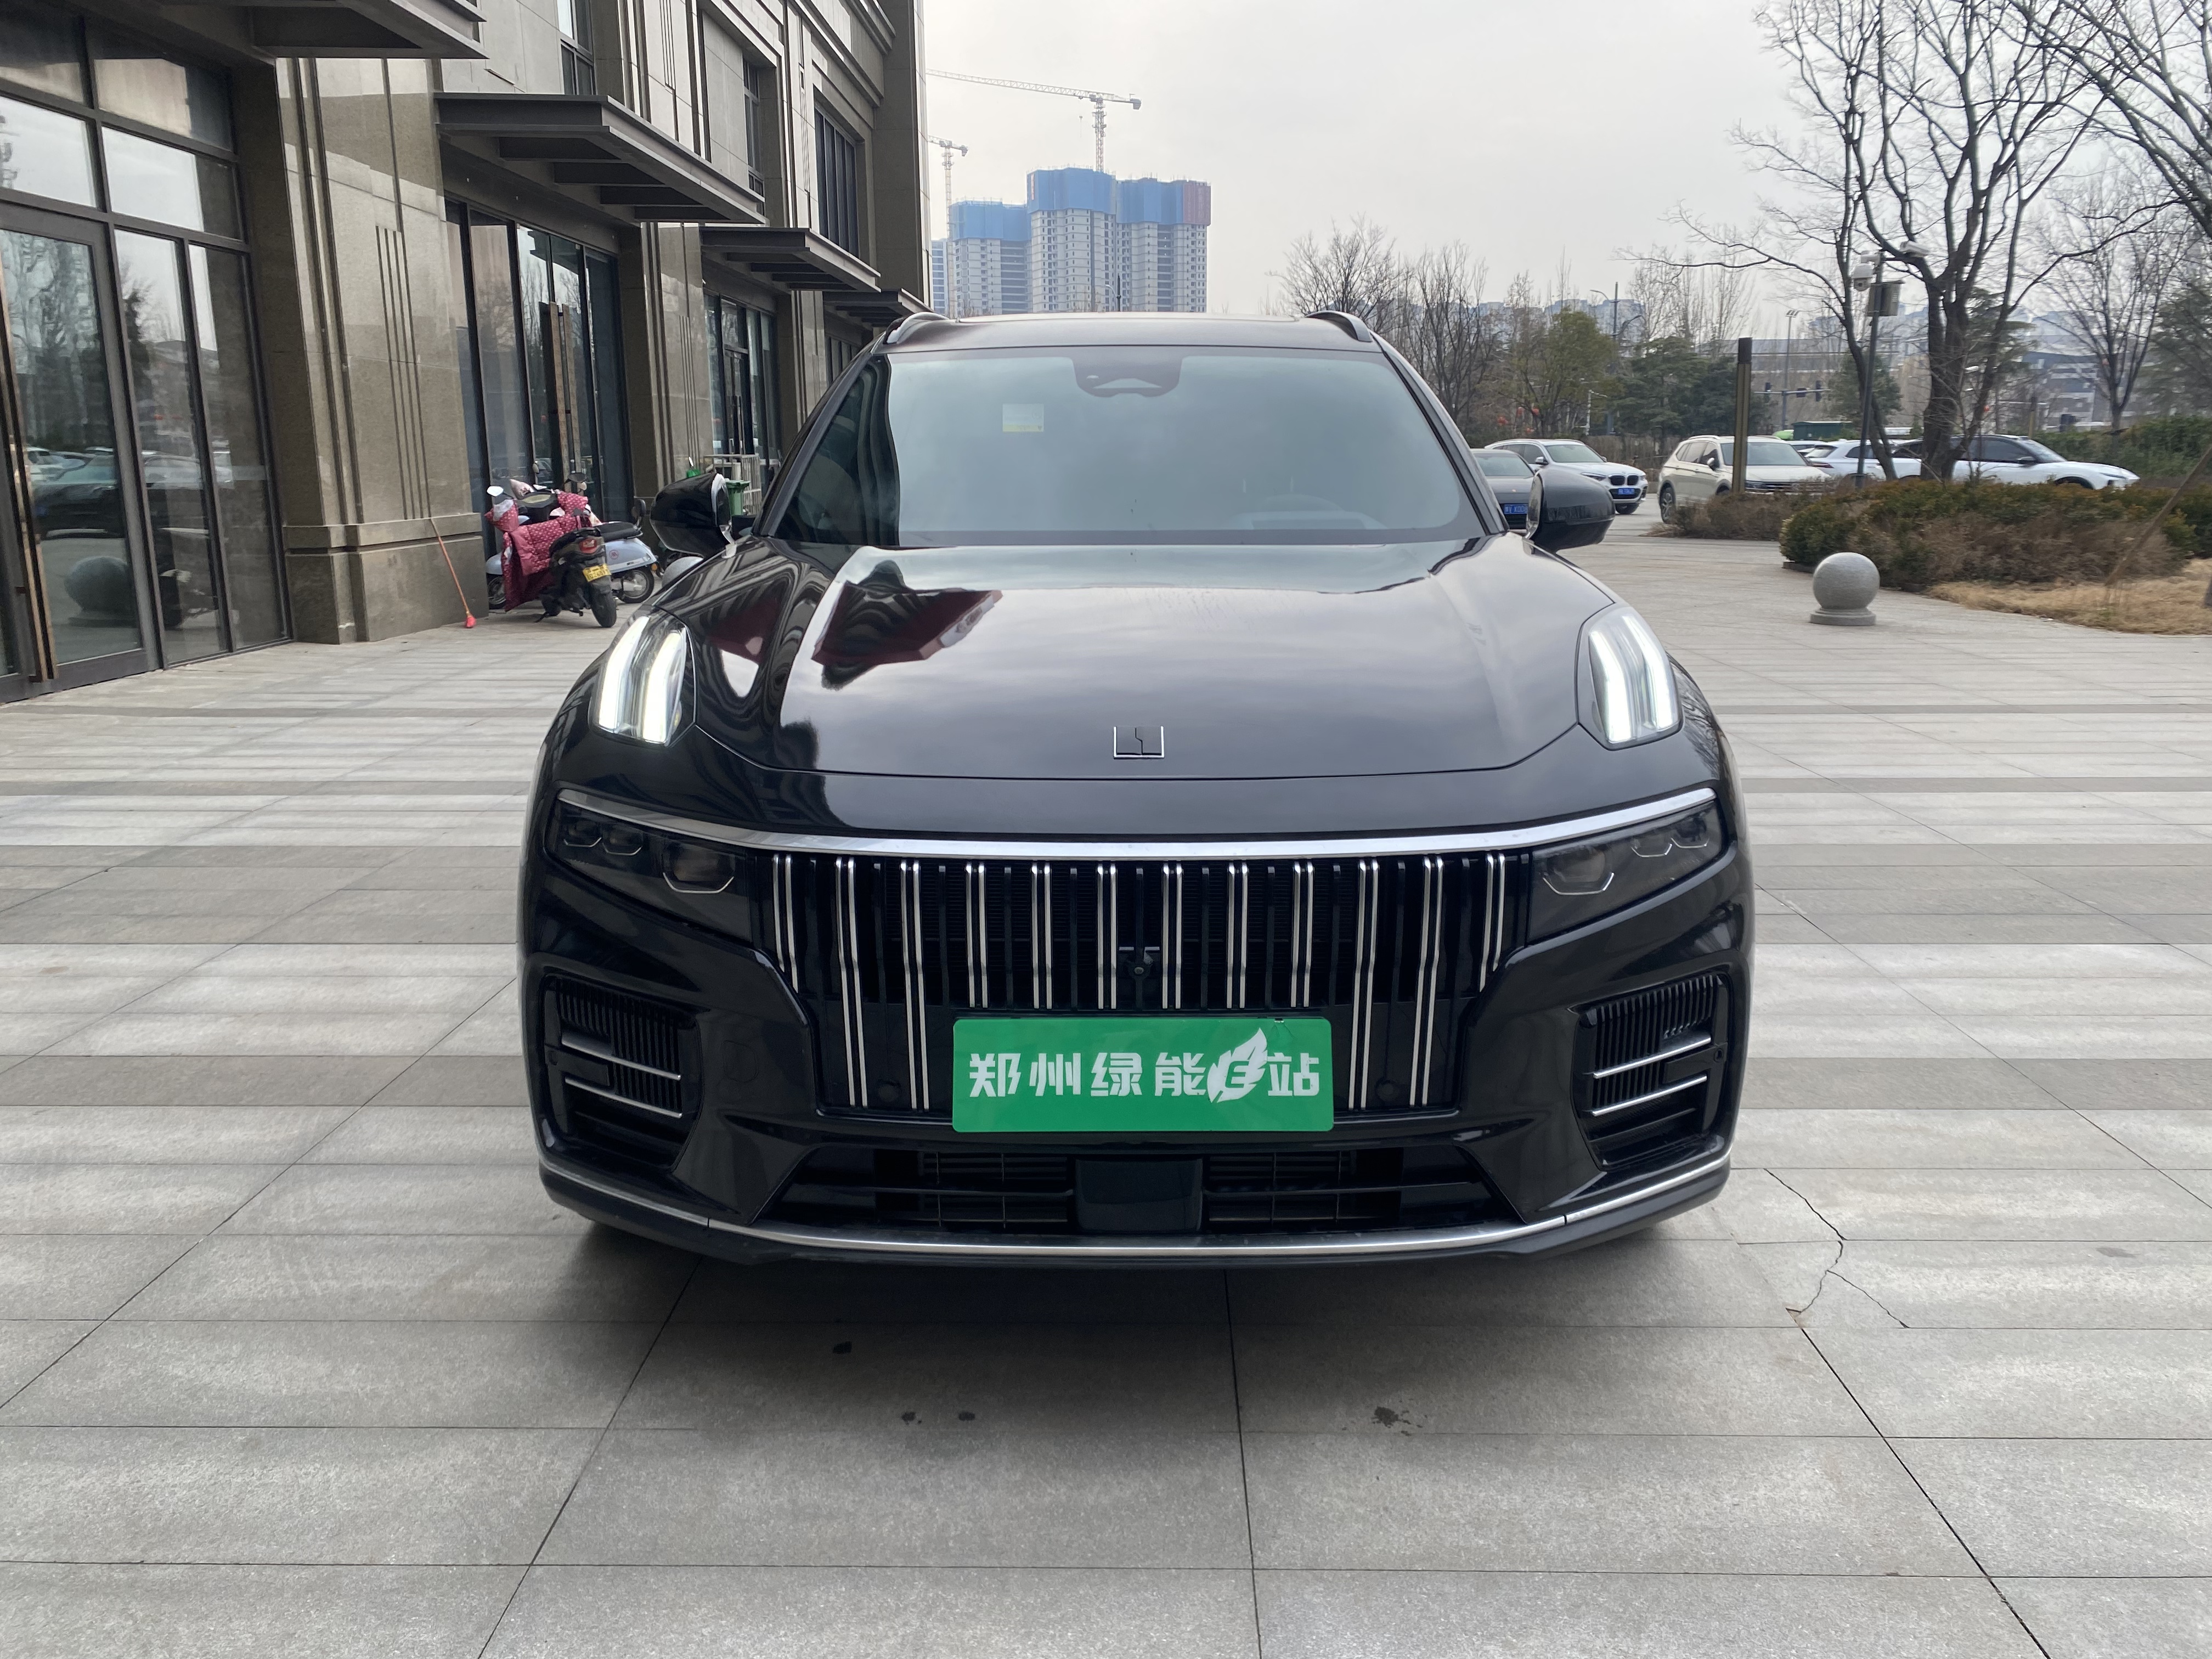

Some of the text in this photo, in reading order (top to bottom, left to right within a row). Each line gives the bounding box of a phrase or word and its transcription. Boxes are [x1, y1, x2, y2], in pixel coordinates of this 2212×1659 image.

[969, 1052, 1319, 1097] 郑州绿能E站
